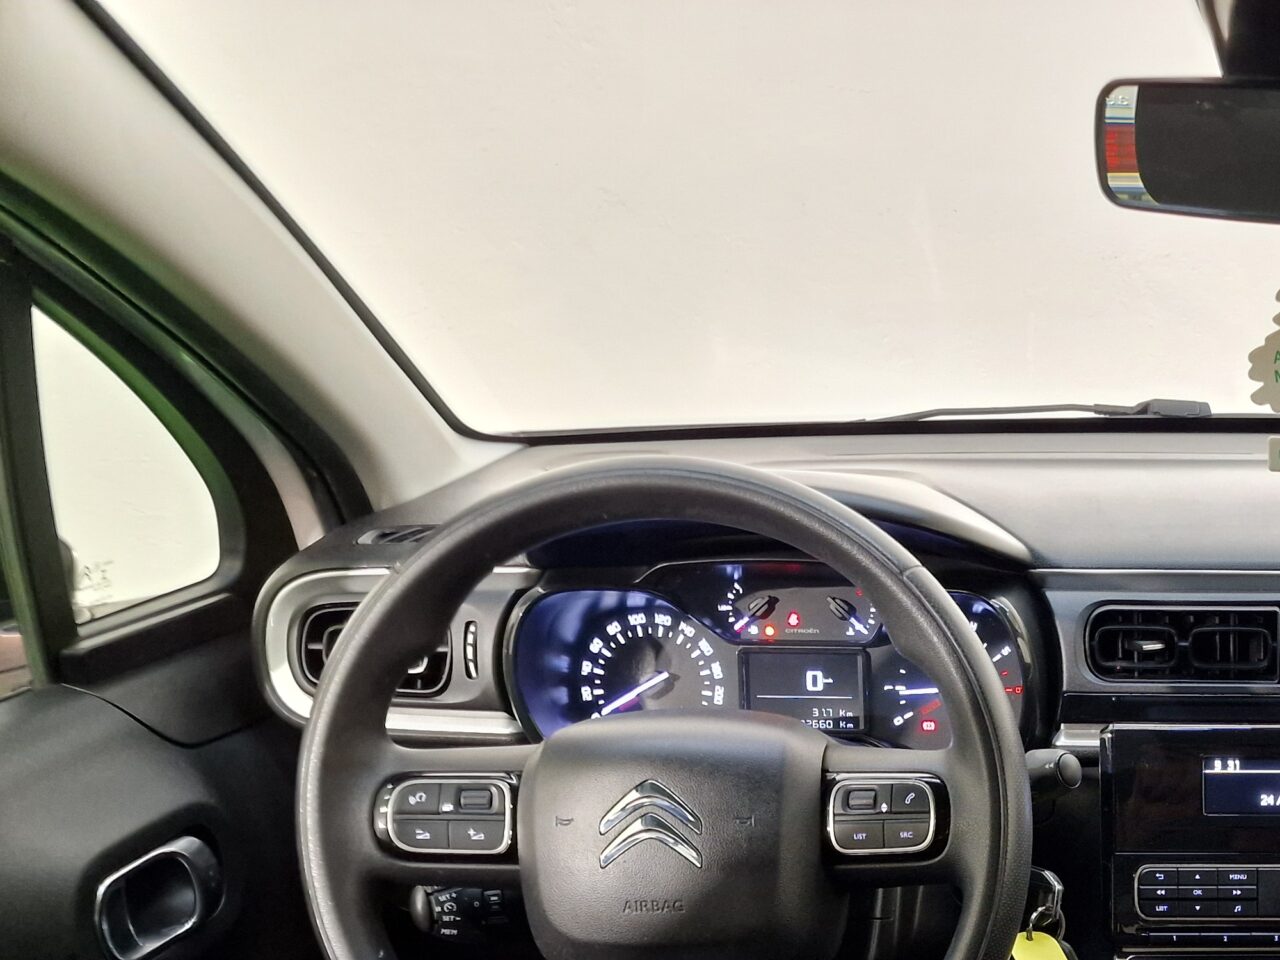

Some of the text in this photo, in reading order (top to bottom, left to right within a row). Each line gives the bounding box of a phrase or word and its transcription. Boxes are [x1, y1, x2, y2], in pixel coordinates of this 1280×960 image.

[628, 613, 646, 625] 100
[654, 613, 672, 626] 120
[606, 621, 621, 635] 80
[679, 621, 695, 637] 140
[589, 637, 603, 653] 60
[581, 660, 592, 675] 40
[581, 686, 592, 701] 20
[714, 685, 724, 705] 200
[812, 707, 853, 717] 317 Km
[840, 720, 853, 728] Km
[1260, 794, 1274, 806] 24
[622, 900, 684, 913] AIRBAG
